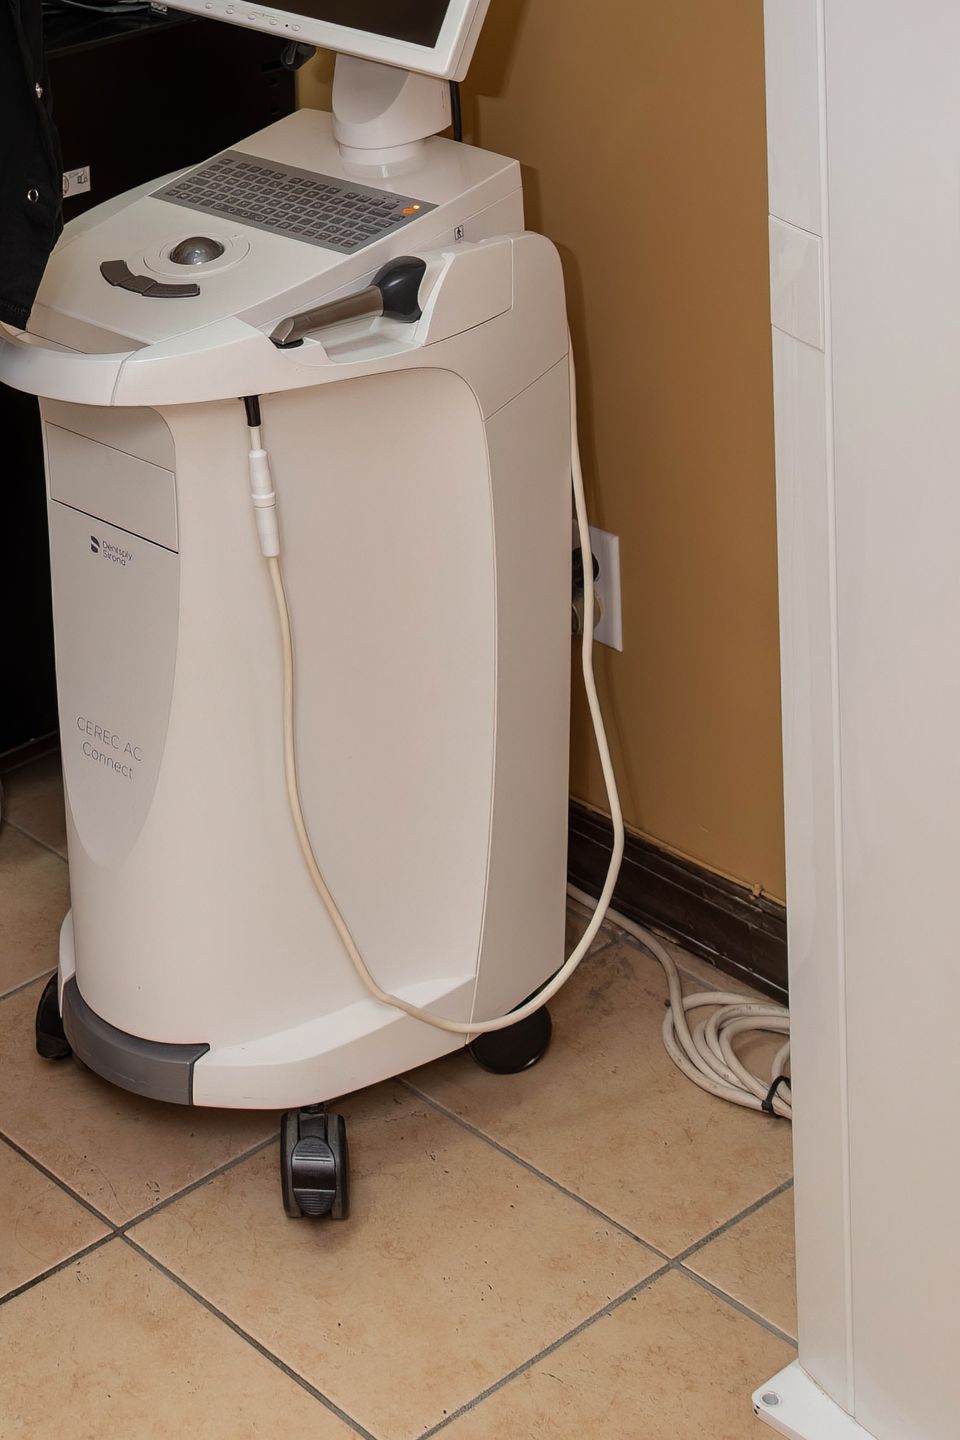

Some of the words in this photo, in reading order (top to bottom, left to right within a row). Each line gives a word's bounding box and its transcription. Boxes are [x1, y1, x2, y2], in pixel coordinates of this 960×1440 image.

[102, 540, 133, 561] Dentsply
[102, 549, 126, 566] Sirona
[76, 716, 120, 750] CEREC
[123, 742, 142, 762] AC
[83, 741, 133, 780] Connect
